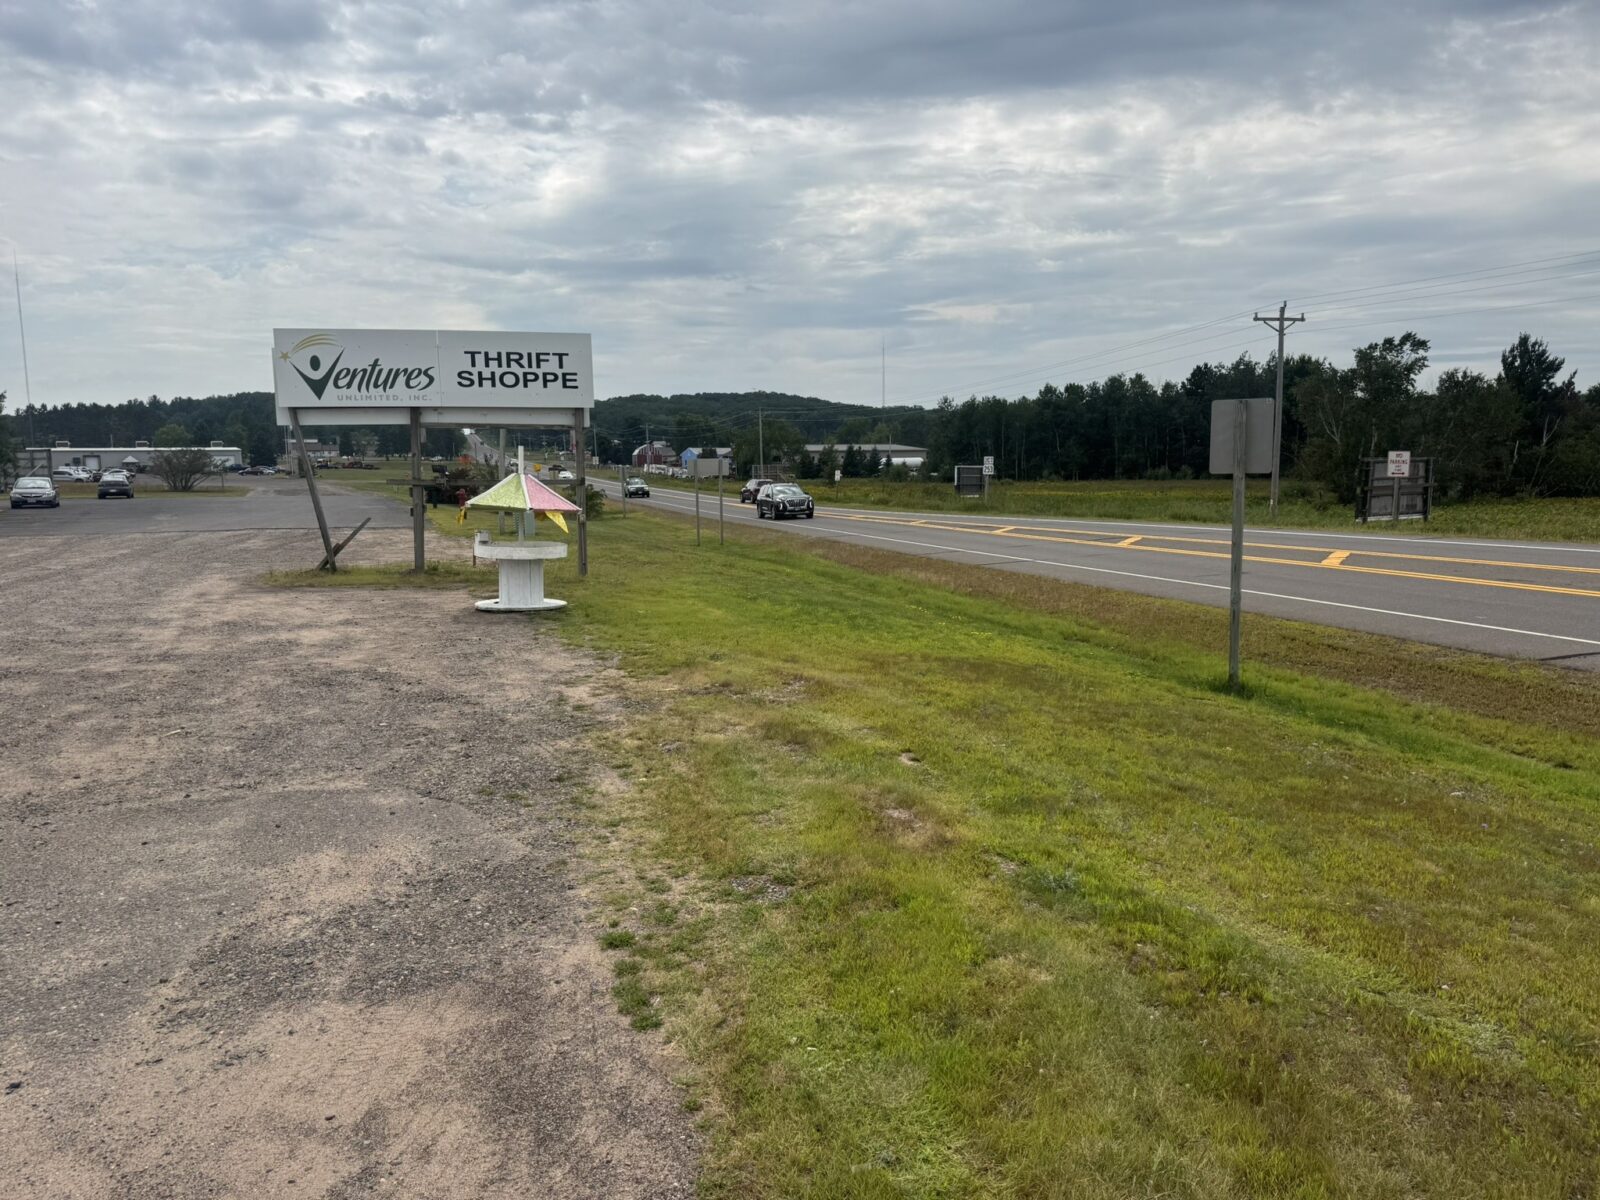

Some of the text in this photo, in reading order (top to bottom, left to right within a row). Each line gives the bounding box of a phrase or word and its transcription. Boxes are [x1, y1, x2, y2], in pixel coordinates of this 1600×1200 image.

[464, 351, 569, 370] THRIFT
[289, 347, 435, 400] Ventures
[457, 370, 578, 389] SHOPPE
